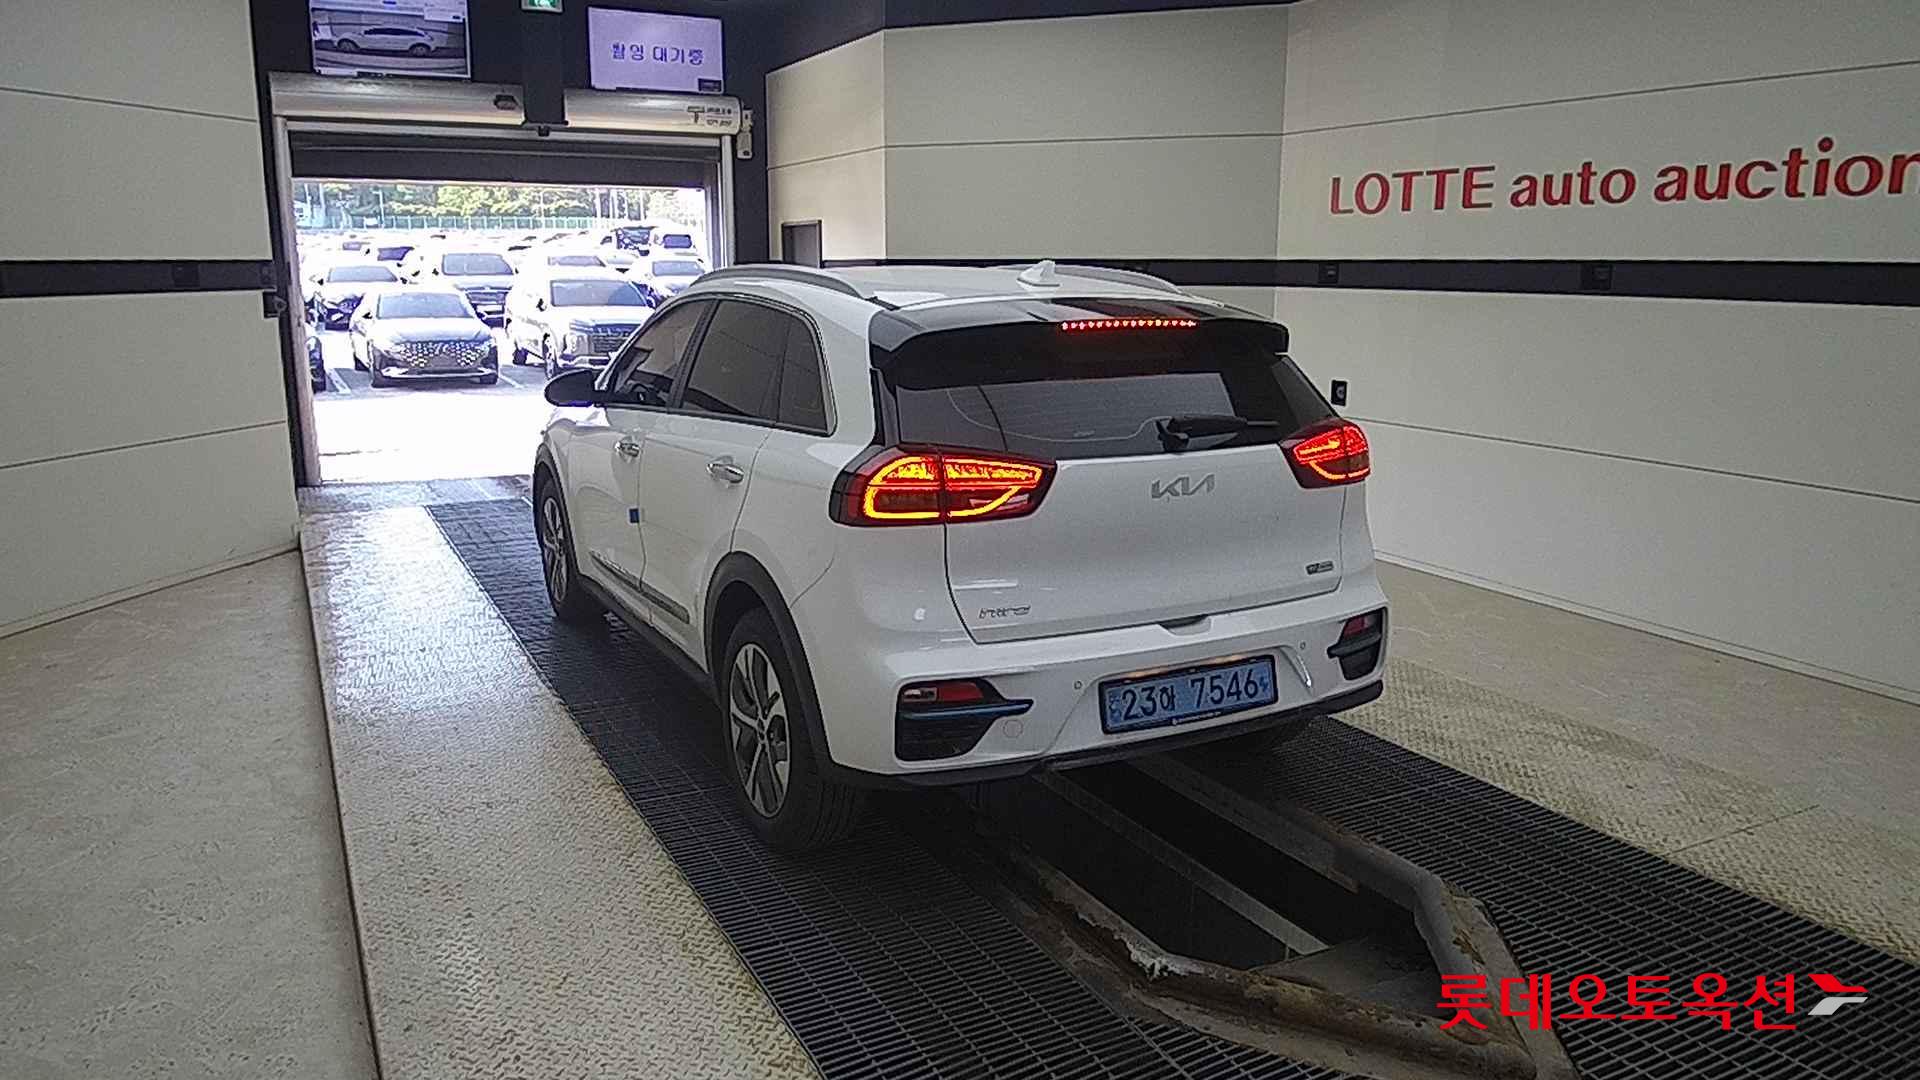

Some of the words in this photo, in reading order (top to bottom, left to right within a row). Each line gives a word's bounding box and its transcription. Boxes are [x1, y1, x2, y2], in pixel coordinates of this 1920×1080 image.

[1330, 166, 1496, 215] LOTTE
[1511, 161, 1636, 209] auto
[1190, 669, 1259, 709] 7546
